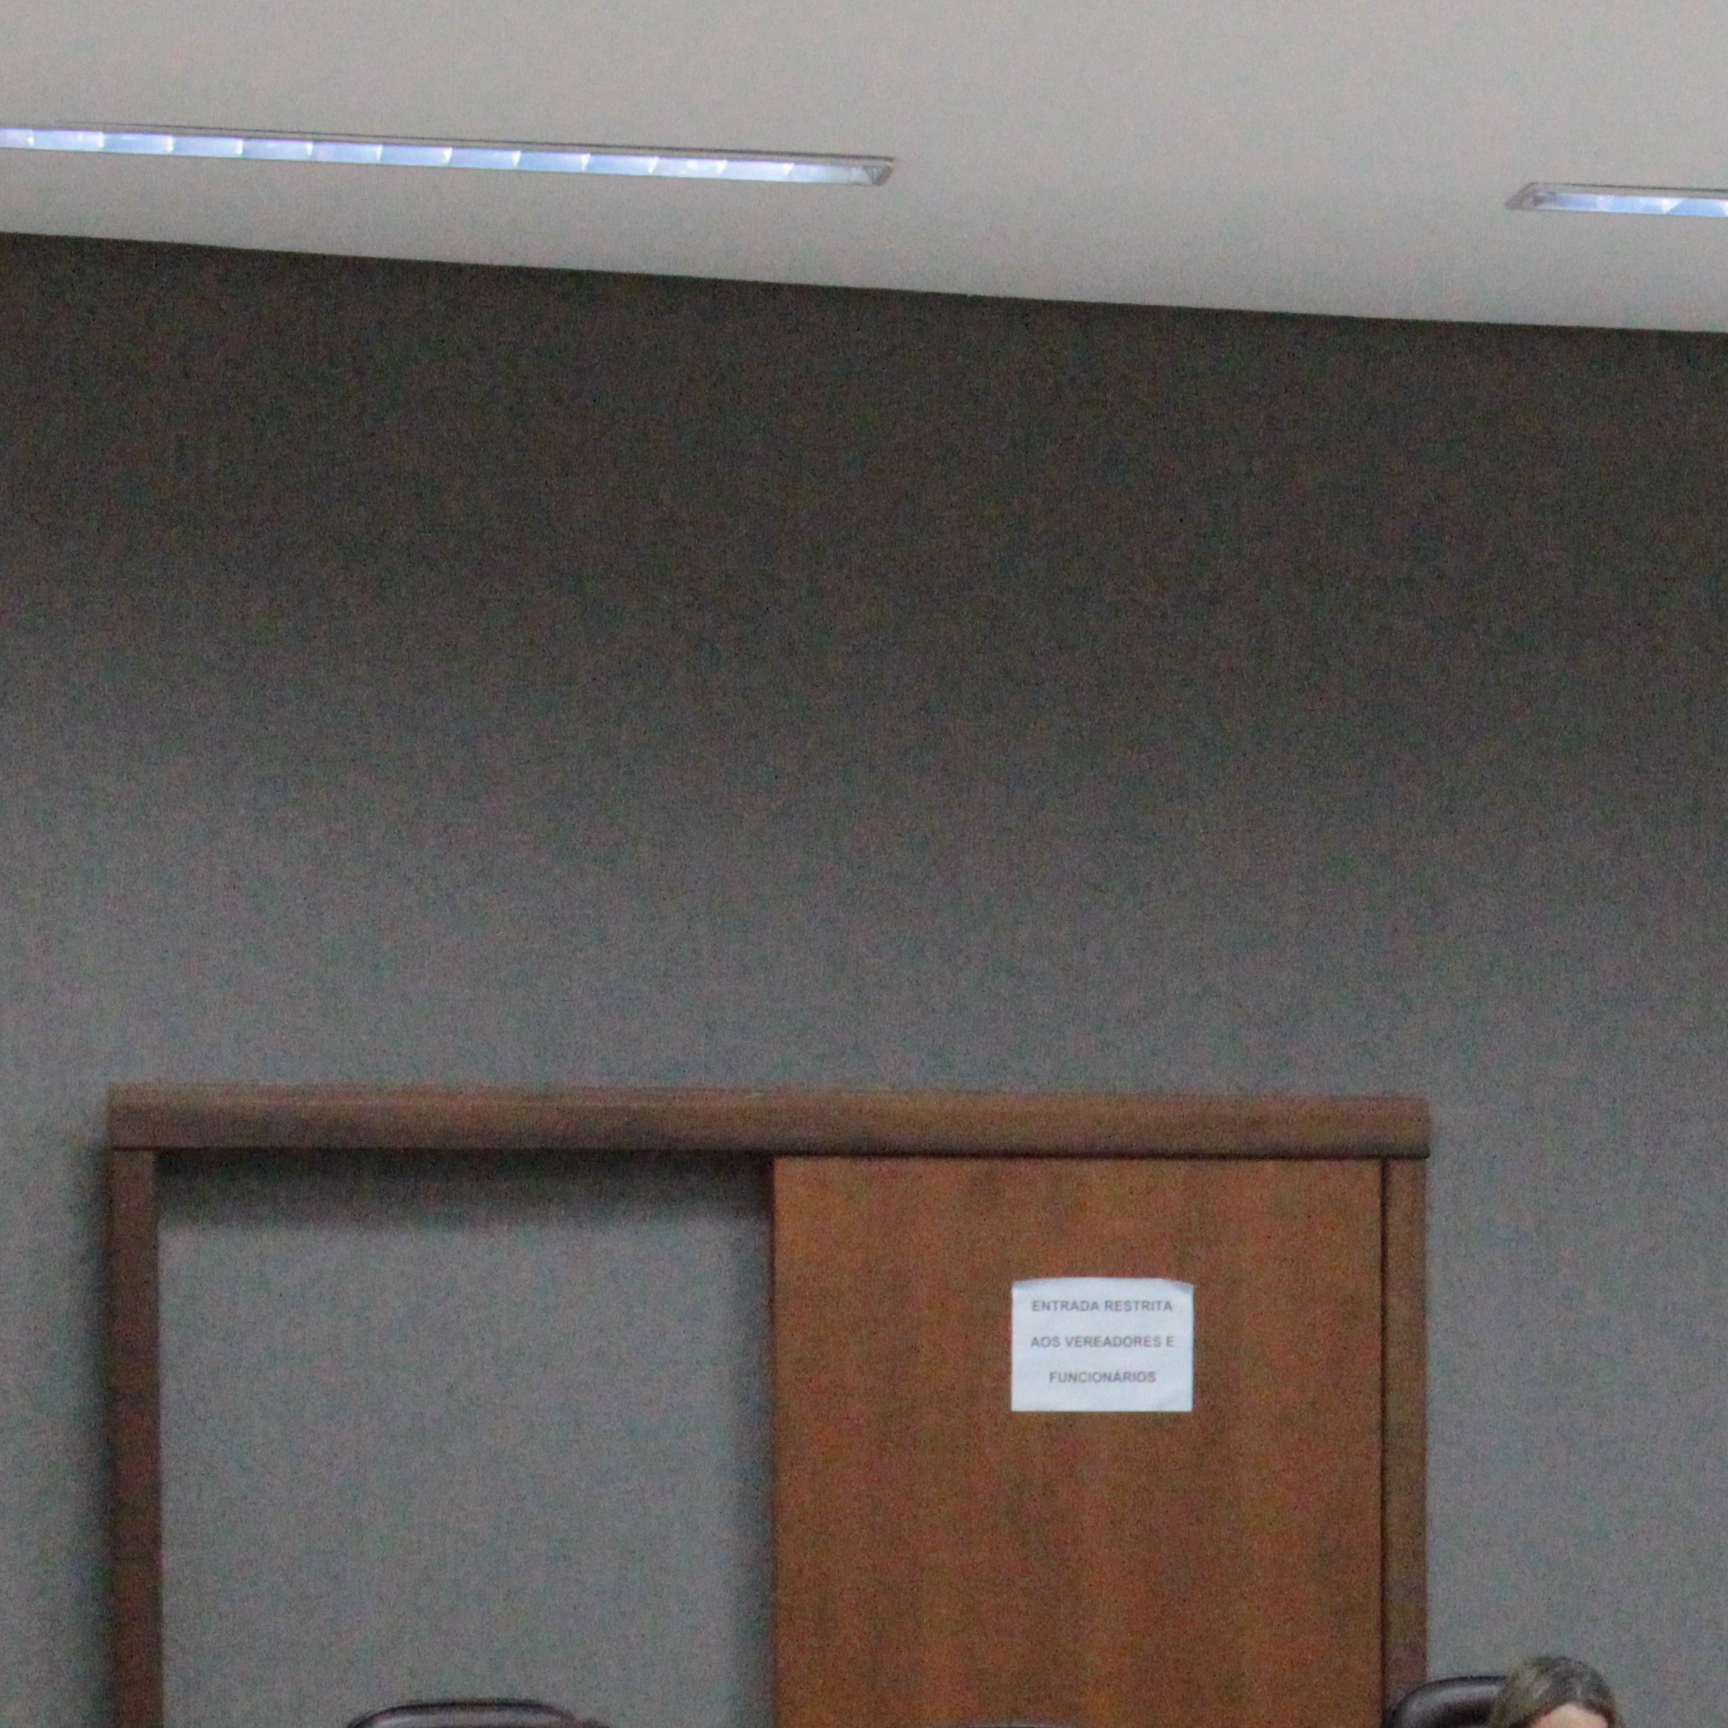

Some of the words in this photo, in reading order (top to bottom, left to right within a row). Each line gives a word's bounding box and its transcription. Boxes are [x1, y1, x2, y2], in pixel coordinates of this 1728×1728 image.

[1031, 1300, 1099, 1312] ENTRADA
[1104, 1300, 1173, 1312] RESTRITA
[1031, 1336, 1060, 1348] AOS
[1065, 1336, 1162, 1348] VEREADORES
[1166, 1336, 1174, 1348] E
[1049, 1369, 1156, 1383] FUNCIONÁRIOS
